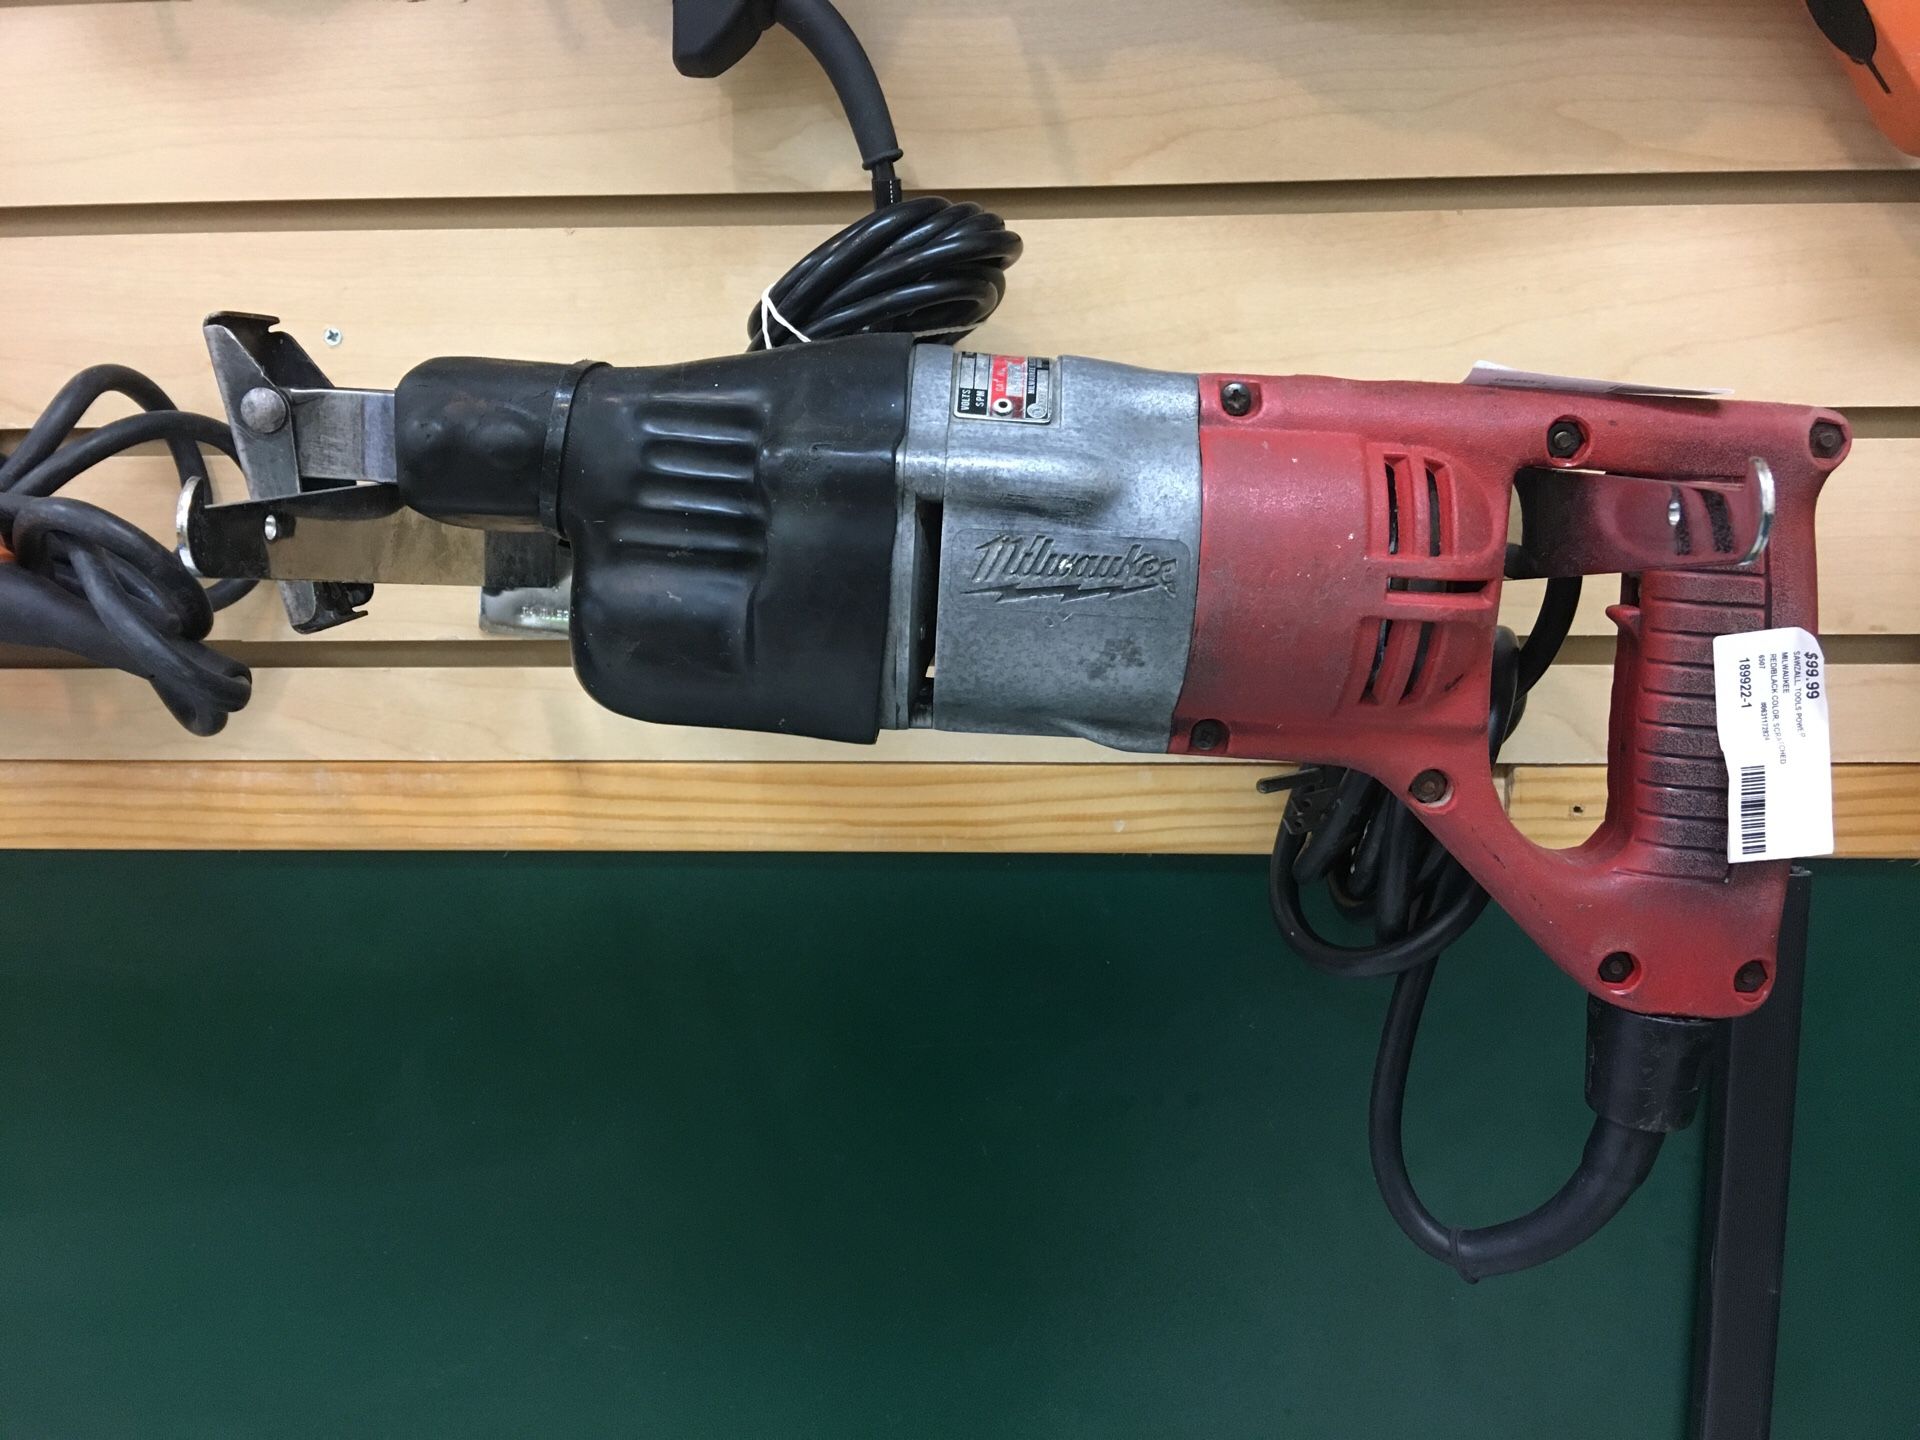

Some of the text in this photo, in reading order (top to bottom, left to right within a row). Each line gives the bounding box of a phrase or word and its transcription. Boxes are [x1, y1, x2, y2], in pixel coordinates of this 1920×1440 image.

[961, 389, 971, 411] VOLTS
[975, 391, 985, 407] SPM
[971, 534, 1177, 598] Milwaukee
[1758, 654, 1766, 670] 6507
[1769, 653, 1778, 694] RED/BLACK
[1782, 652, 1790, 694] MILWAUKEE
[1804, 651, 1820, 699] $99.99
[1738, 657, 1752, 709] 189922-1
[1794, 687, 1802, 711] TOOLS
